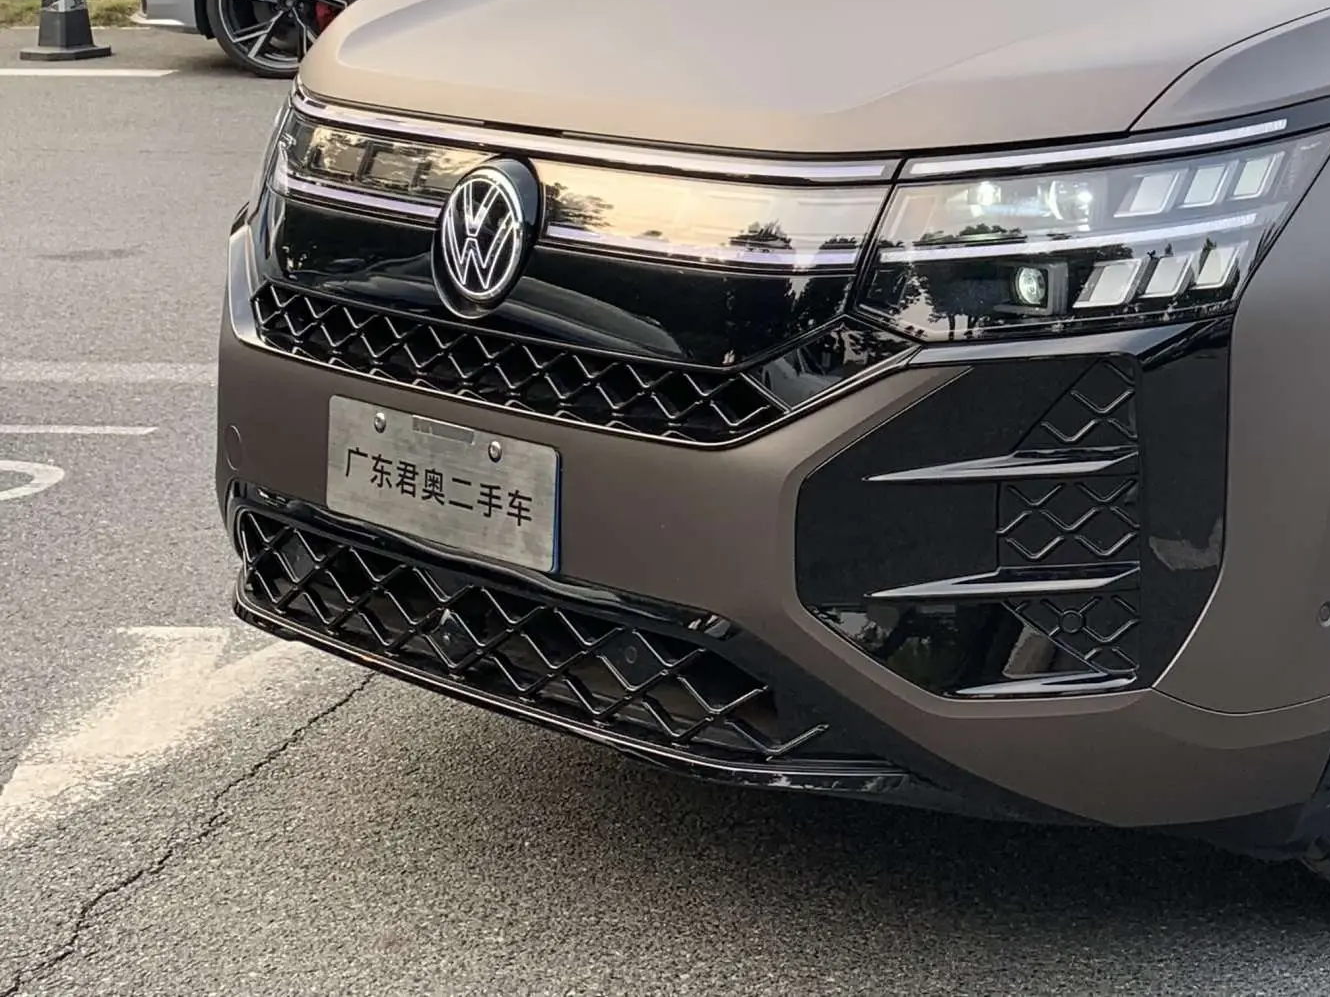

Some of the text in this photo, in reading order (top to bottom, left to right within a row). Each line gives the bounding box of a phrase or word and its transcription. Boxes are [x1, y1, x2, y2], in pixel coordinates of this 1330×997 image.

[345, 447, 532, 527] 广东君奥二手车
